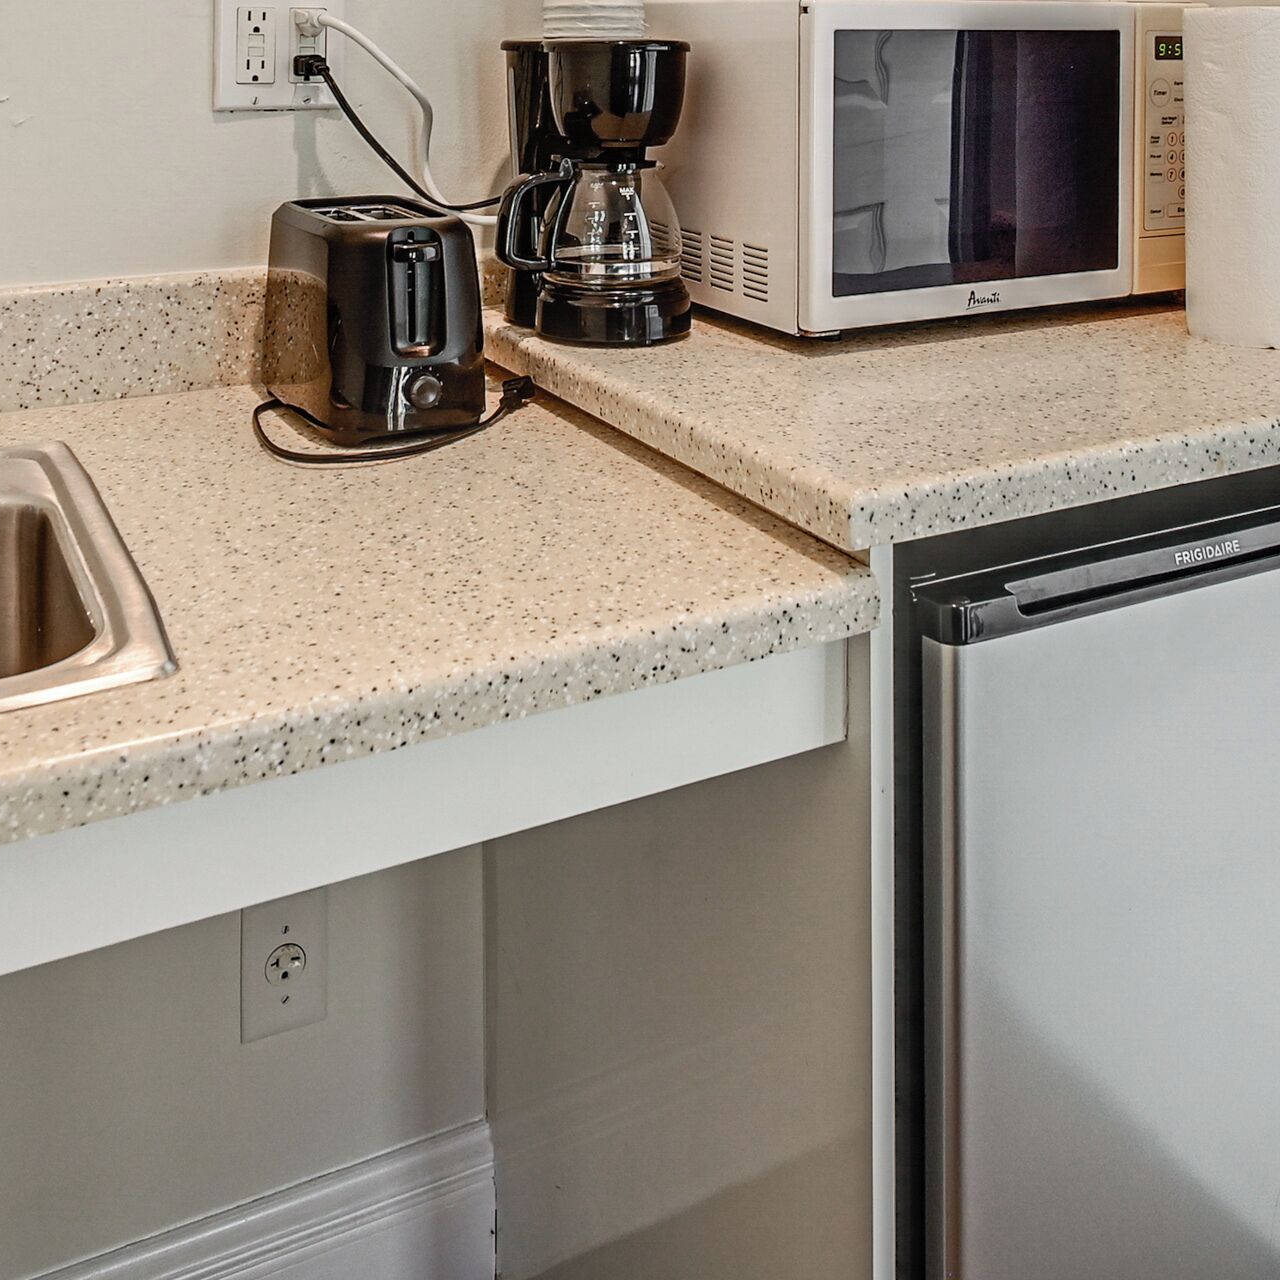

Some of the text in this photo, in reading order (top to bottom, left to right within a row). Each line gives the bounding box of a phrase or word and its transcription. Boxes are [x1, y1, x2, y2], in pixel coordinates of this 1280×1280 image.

[1159, 43, 1182, 57] 9:5
[619, 186, 635, 194] MAX
[967, 290, 1000, 307] Avanti
[1174, 539, 1241, 566] FRIGIDAIRE
